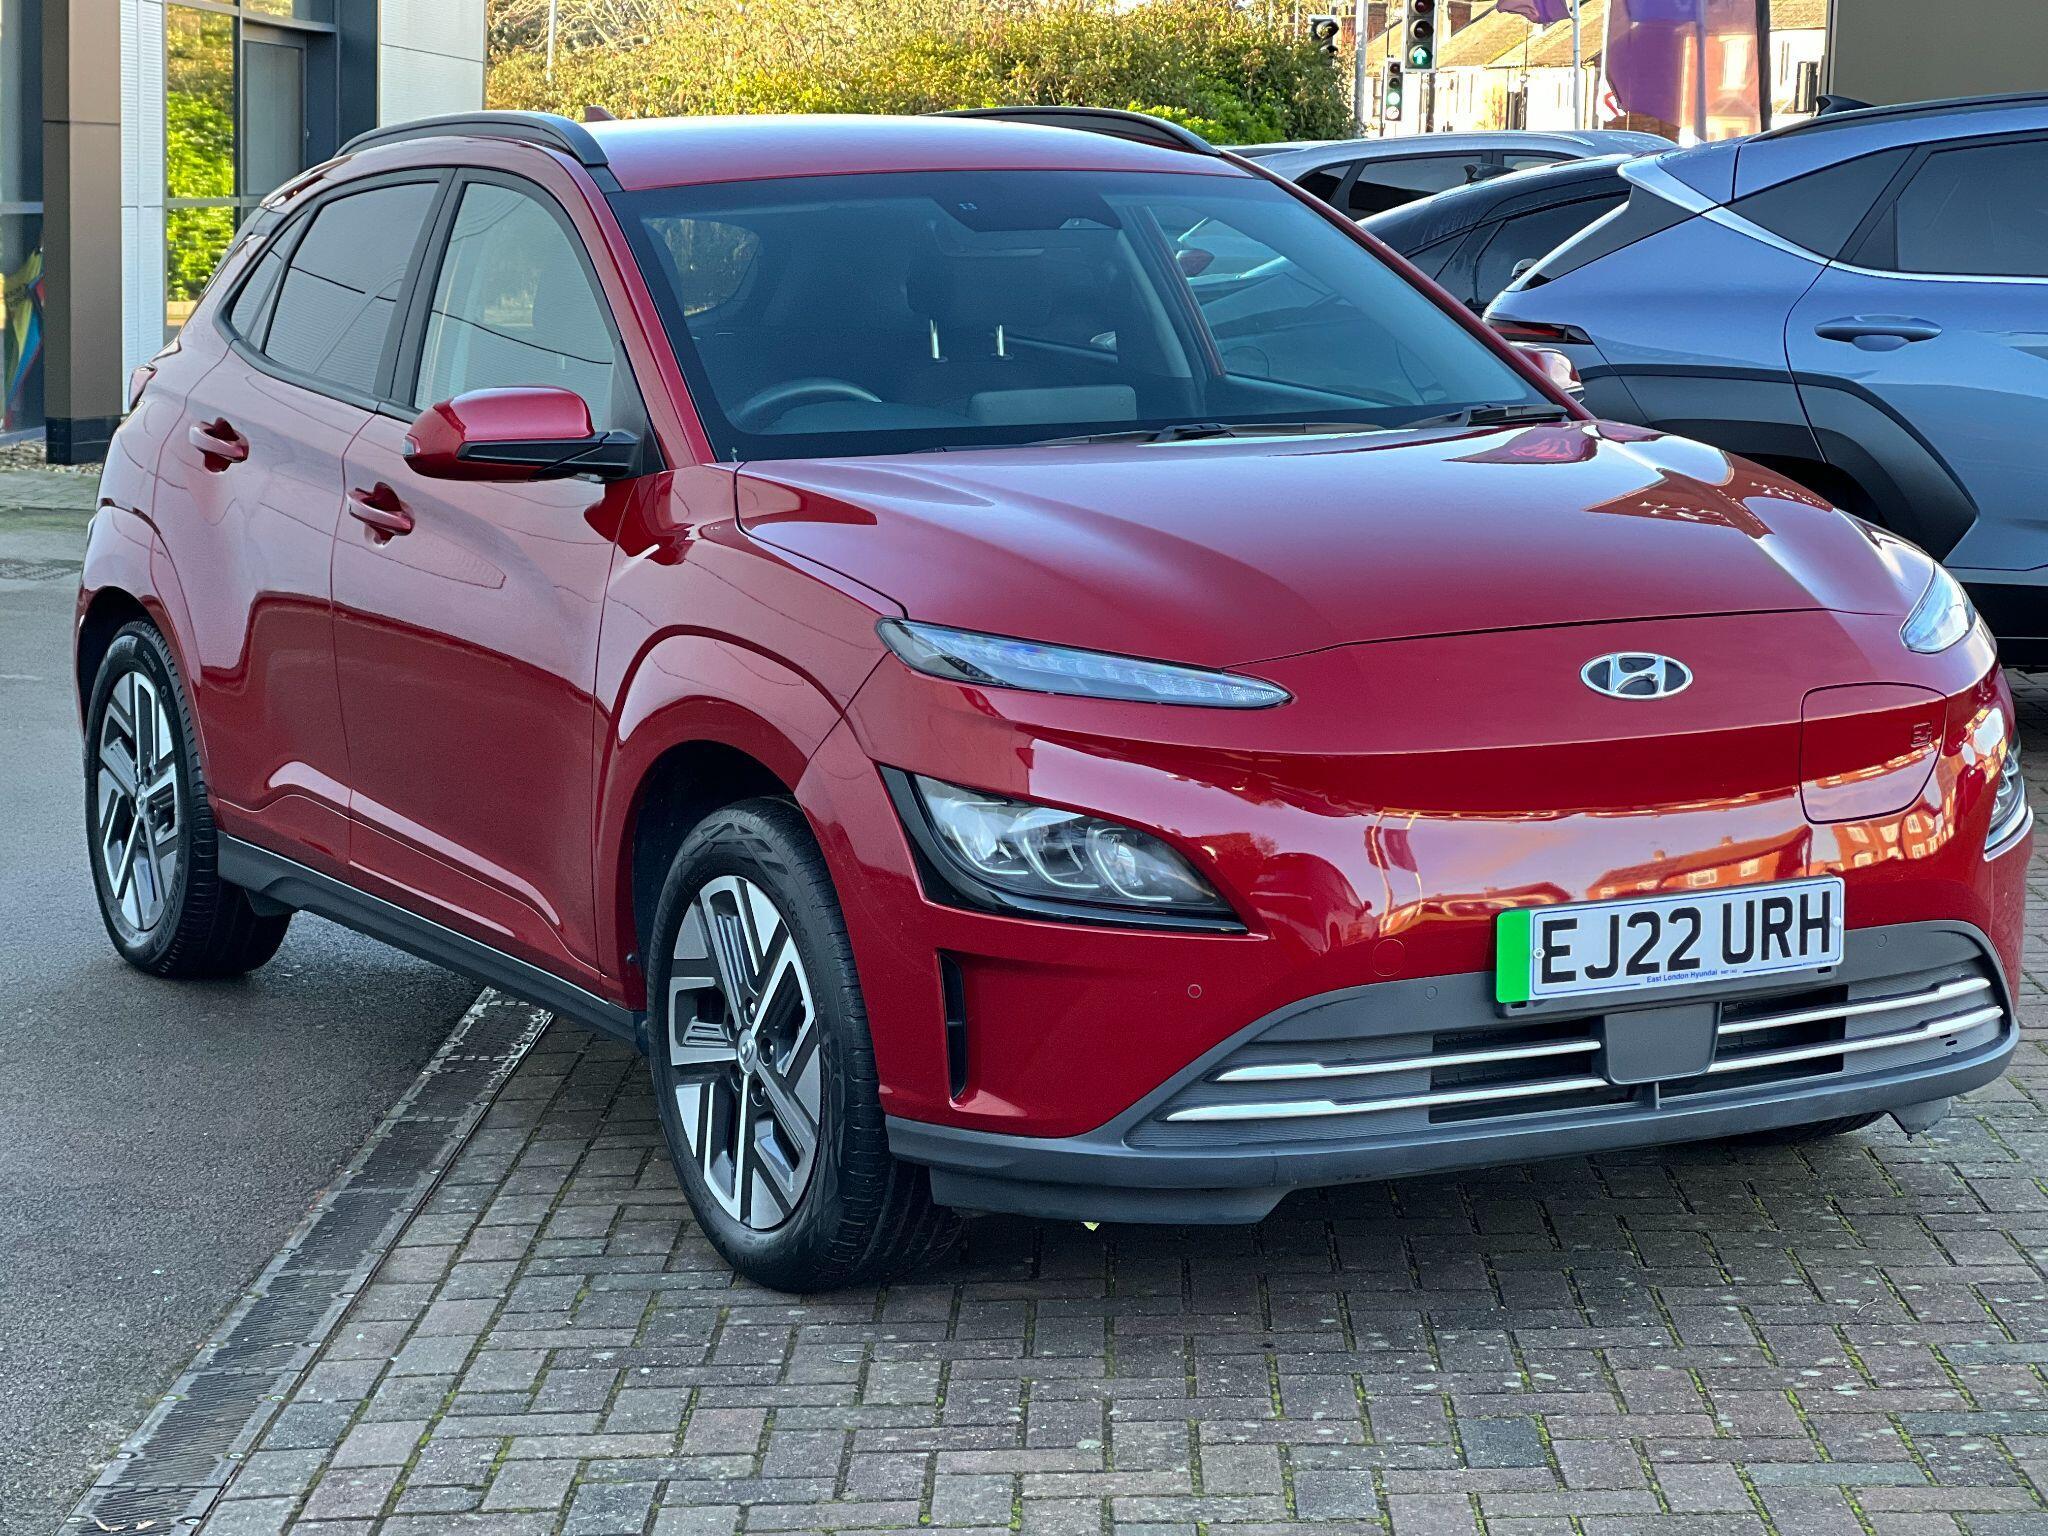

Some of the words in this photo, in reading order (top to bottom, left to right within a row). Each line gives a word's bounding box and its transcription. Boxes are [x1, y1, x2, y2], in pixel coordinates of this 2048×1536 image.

[1541, 906, 1702, 984] EJ22
[1722, 891, 1831, 965] URH
[1663, 973, 1689, 981] London
[1690, 969, 1718, 979] Hyundai
